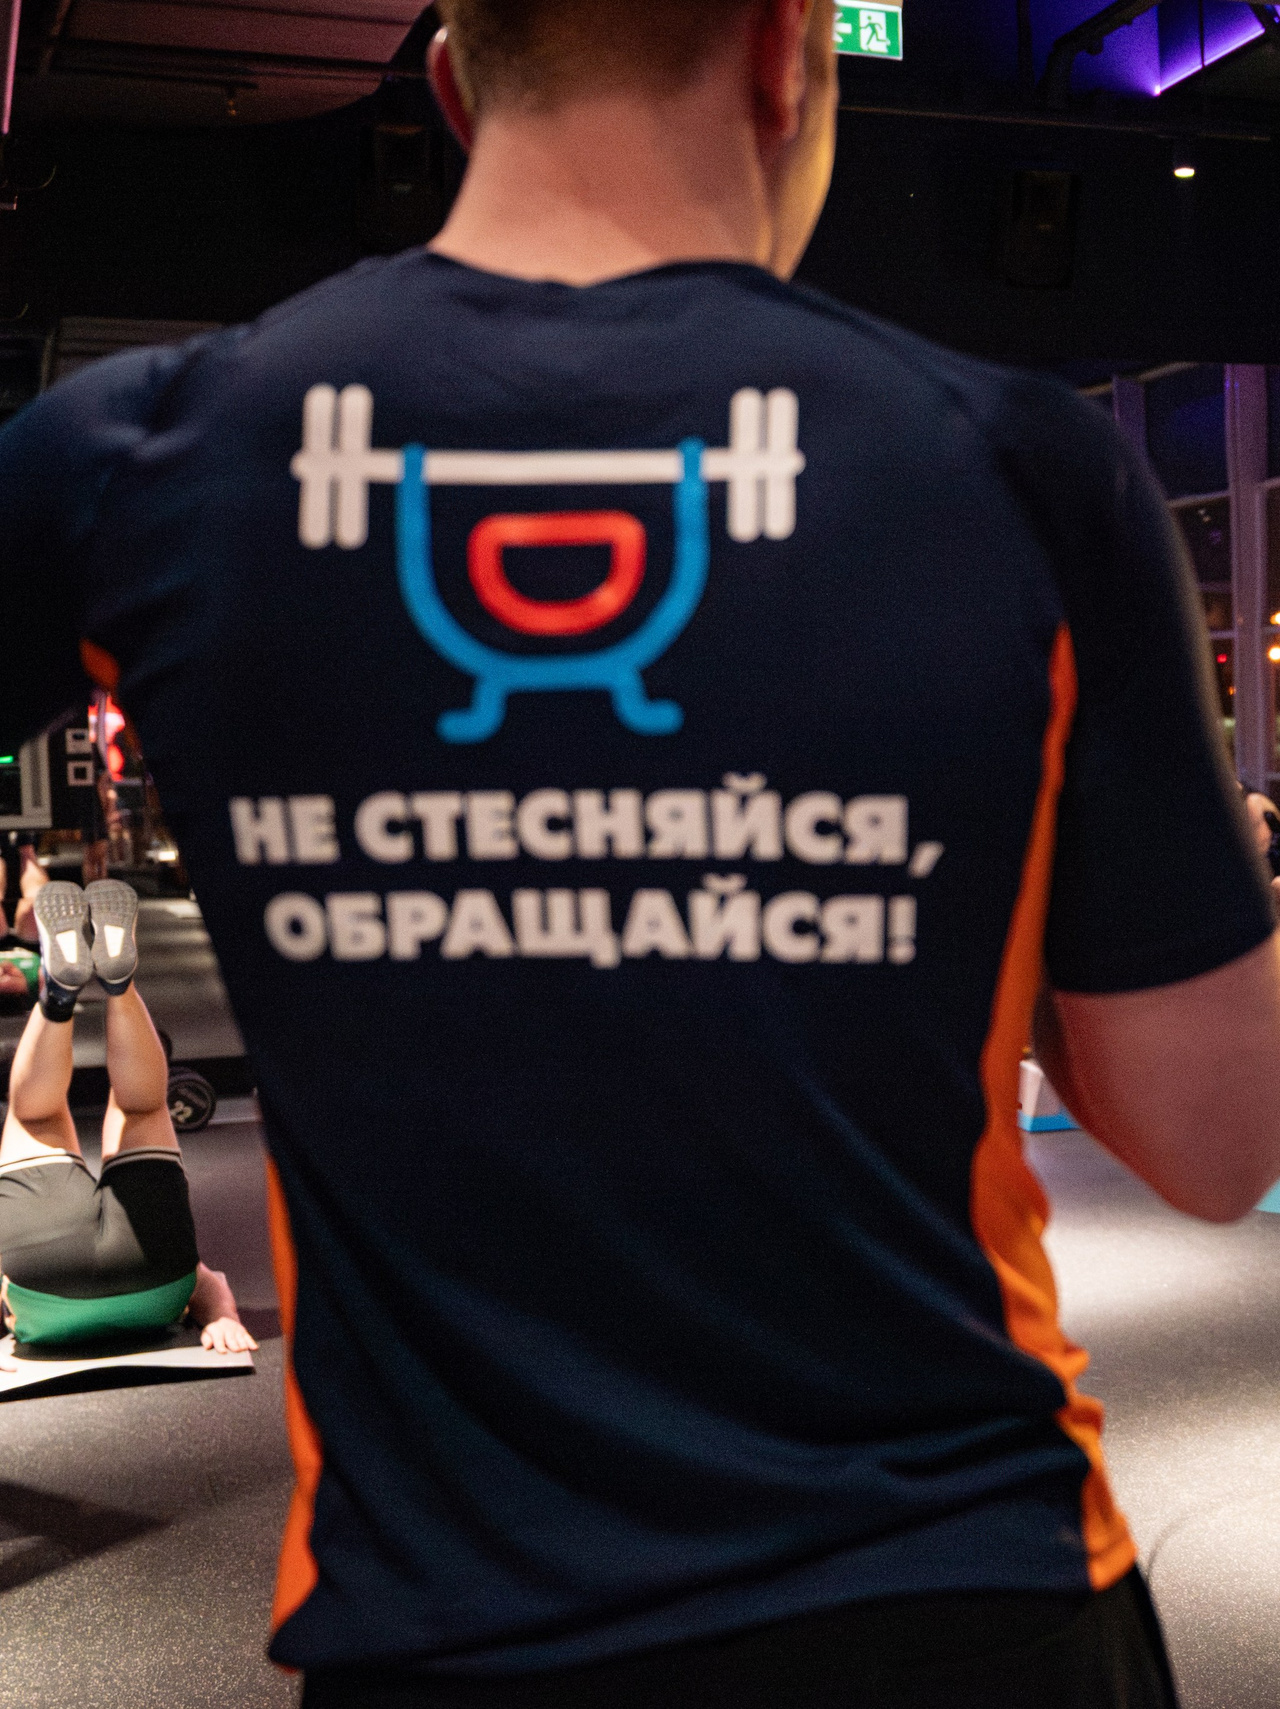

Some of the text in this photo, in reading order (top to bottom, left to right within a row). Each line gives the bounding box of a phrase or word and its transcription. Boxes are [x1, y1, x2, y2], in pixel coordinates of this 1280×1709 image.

[229, 772, 944, 879] НЕ СТЕСНЯЙСЯ,
[263, 873, 917, 969] ОБРАЩАЙСЯ!
